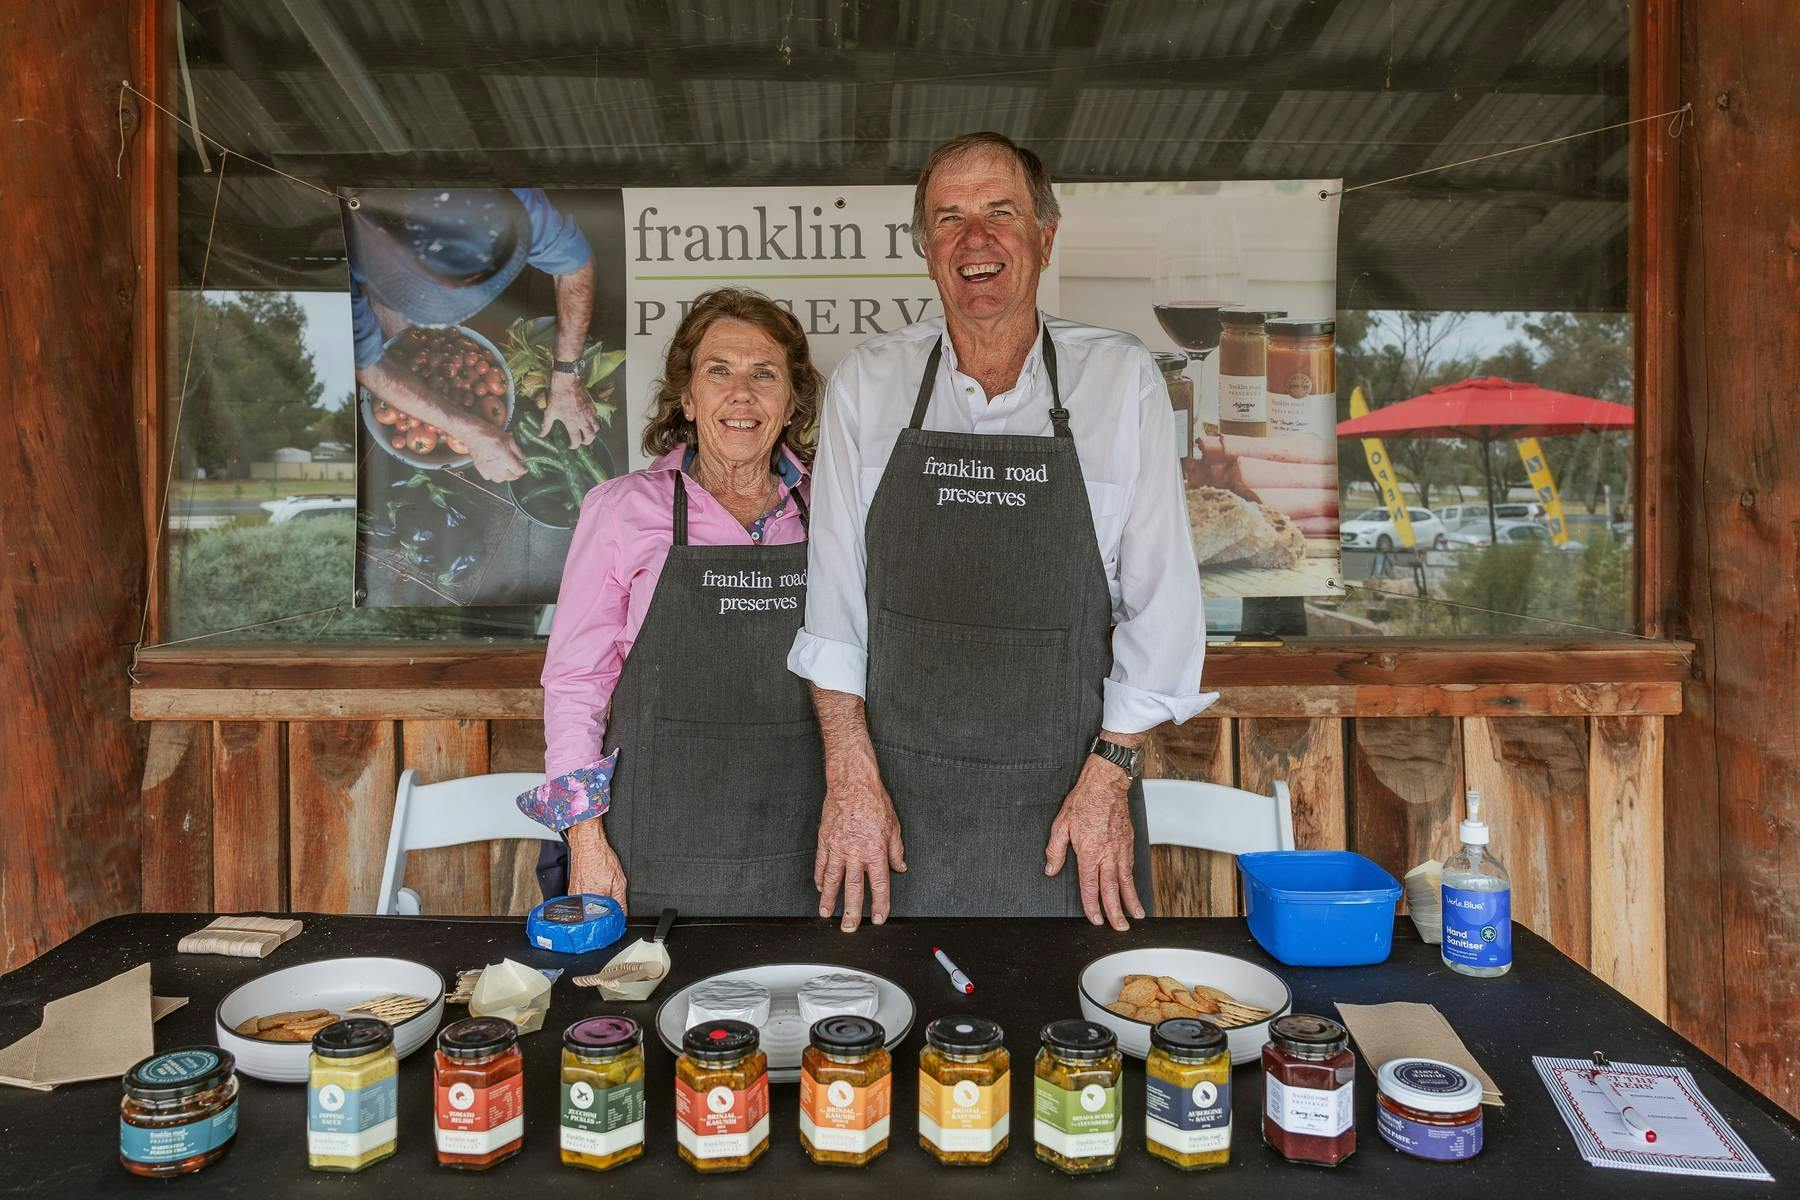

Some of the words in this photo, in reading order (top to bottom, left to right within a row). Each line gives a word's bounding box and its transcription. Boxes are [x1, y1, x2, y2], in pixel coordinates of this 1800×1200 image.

[633, 205, 866, 262] franklin
[923, 456, 995, 480] franklin
[1005, 464, 1048, 482] road
[937, 487, 1026, 506] preserves
[702, 570, 773, 589] franklin
[719, 596, 797, 614] preserves
[1446, 926, 1467, 938] Hand
[1446, 936, 1483, 950] Sanitiser
[1188, 1108, 1223, 1118] AUBERGINE
